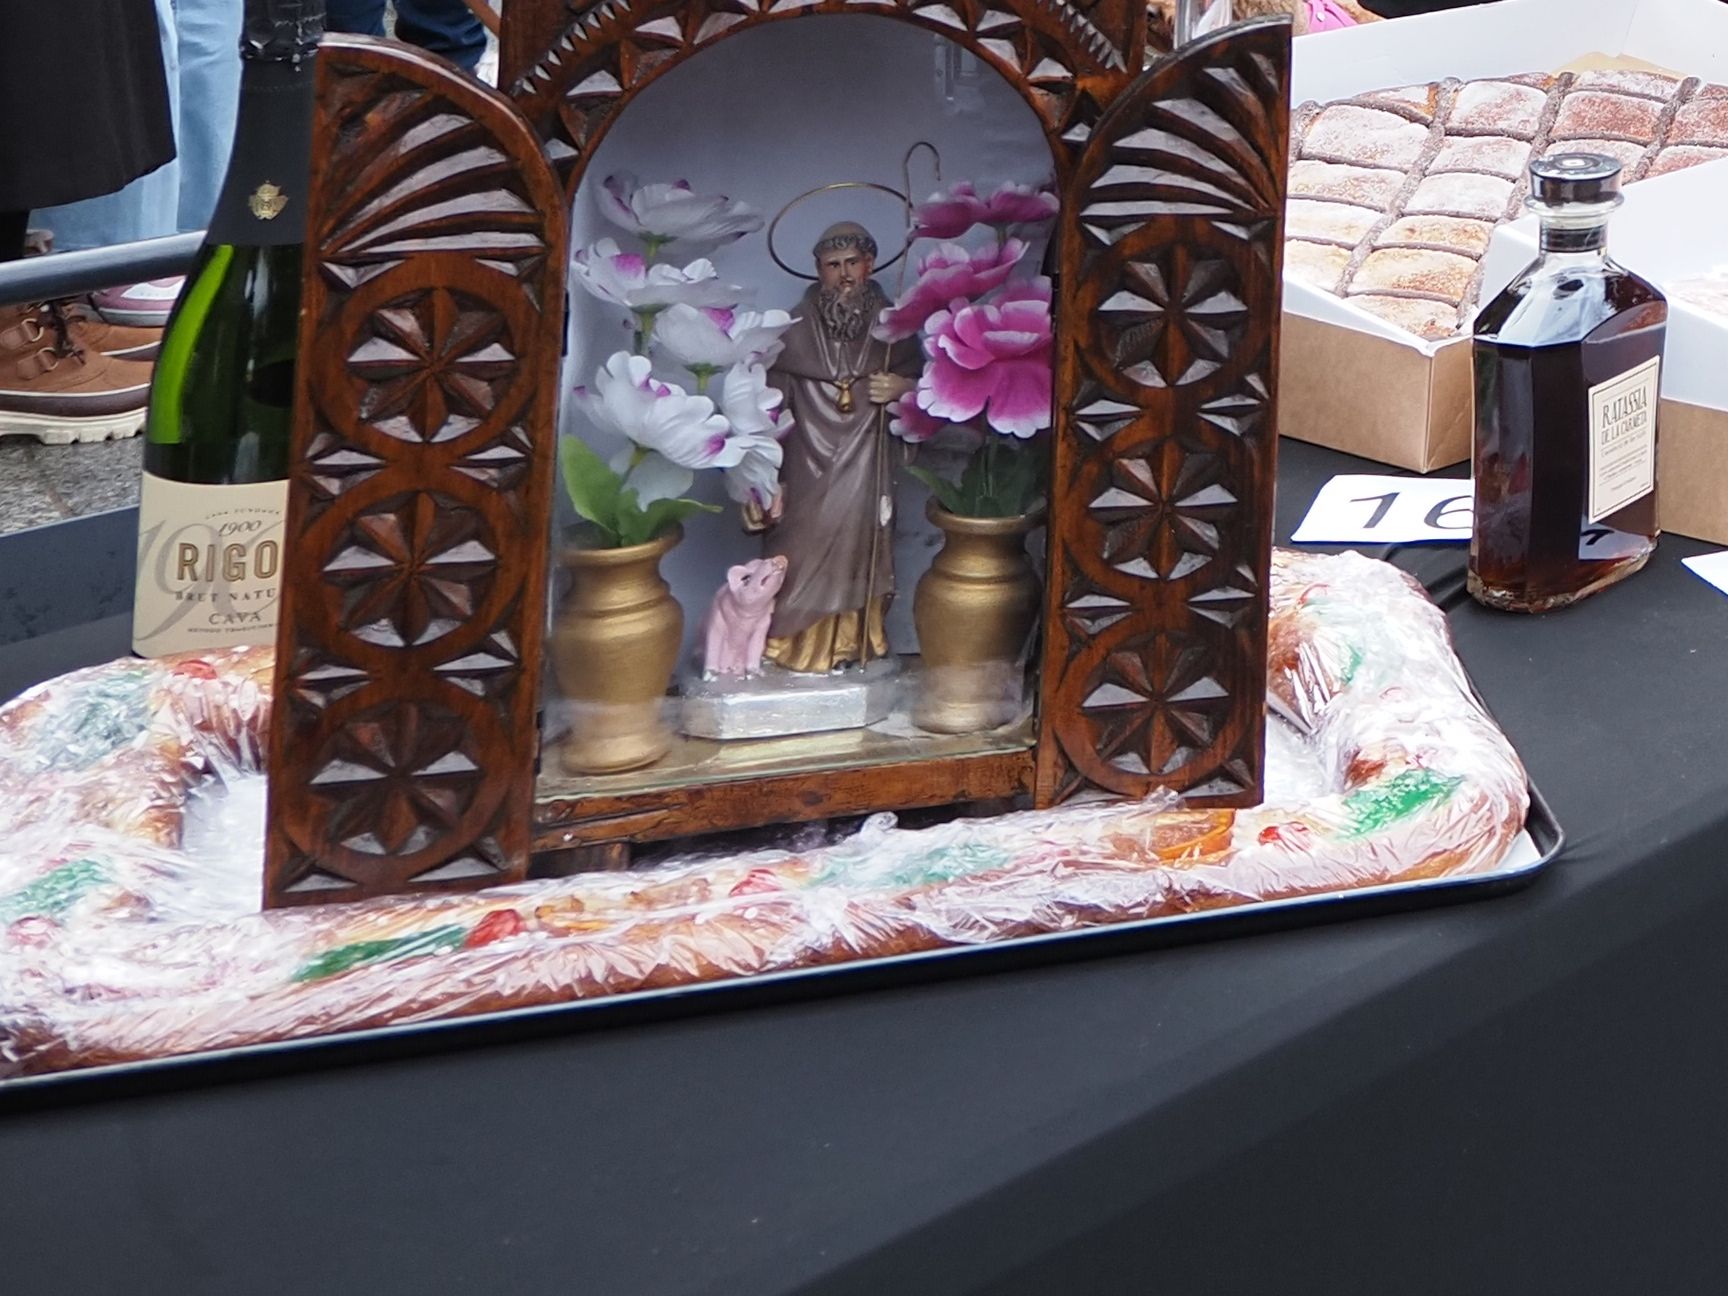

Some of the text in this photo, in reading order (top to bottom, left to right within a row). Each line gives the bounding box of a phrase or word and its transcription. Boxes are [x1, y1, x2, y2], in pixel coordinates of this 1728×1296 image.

[1350, 492, 1473, 530] 16
[219, 520, 262, 537] 1900
[176, 540, 279, 583] RIGO
[229, 588, 277, 601] NATU
[208, 612, 261, 625] CAVA
